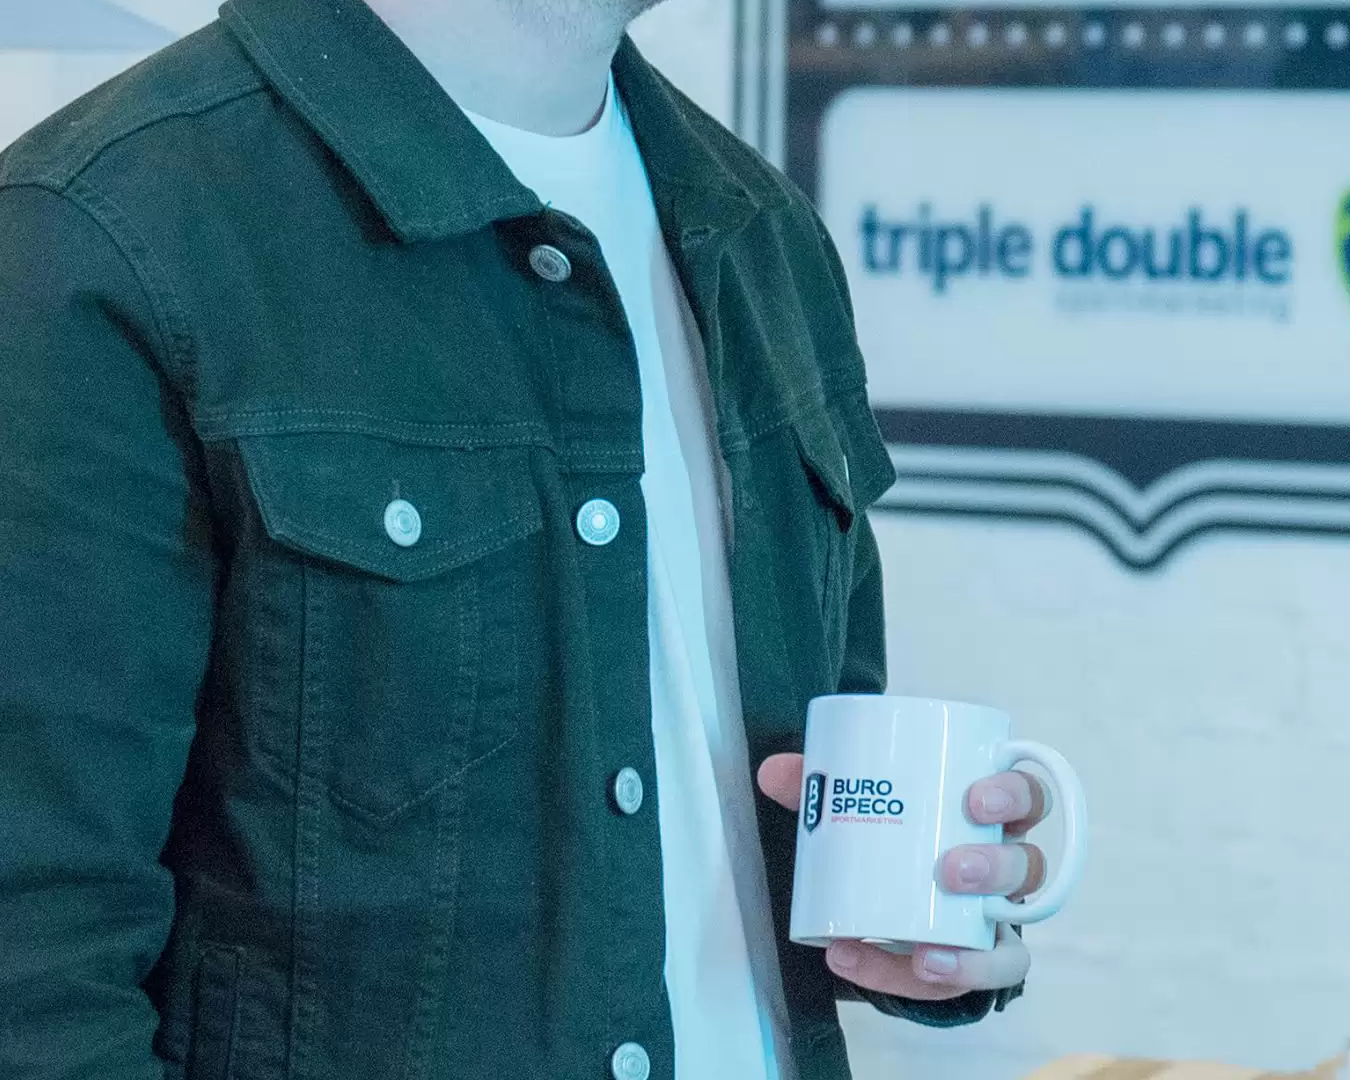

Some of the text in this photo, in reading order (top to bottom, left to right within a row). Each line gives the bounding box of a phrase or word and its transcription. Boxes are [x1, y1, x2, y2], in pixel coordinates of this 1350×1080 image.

[860, 199, 1294, 297] triple double
[833, 779, 892, 795] BURO
[832, 798, 904, 815] SPECO
